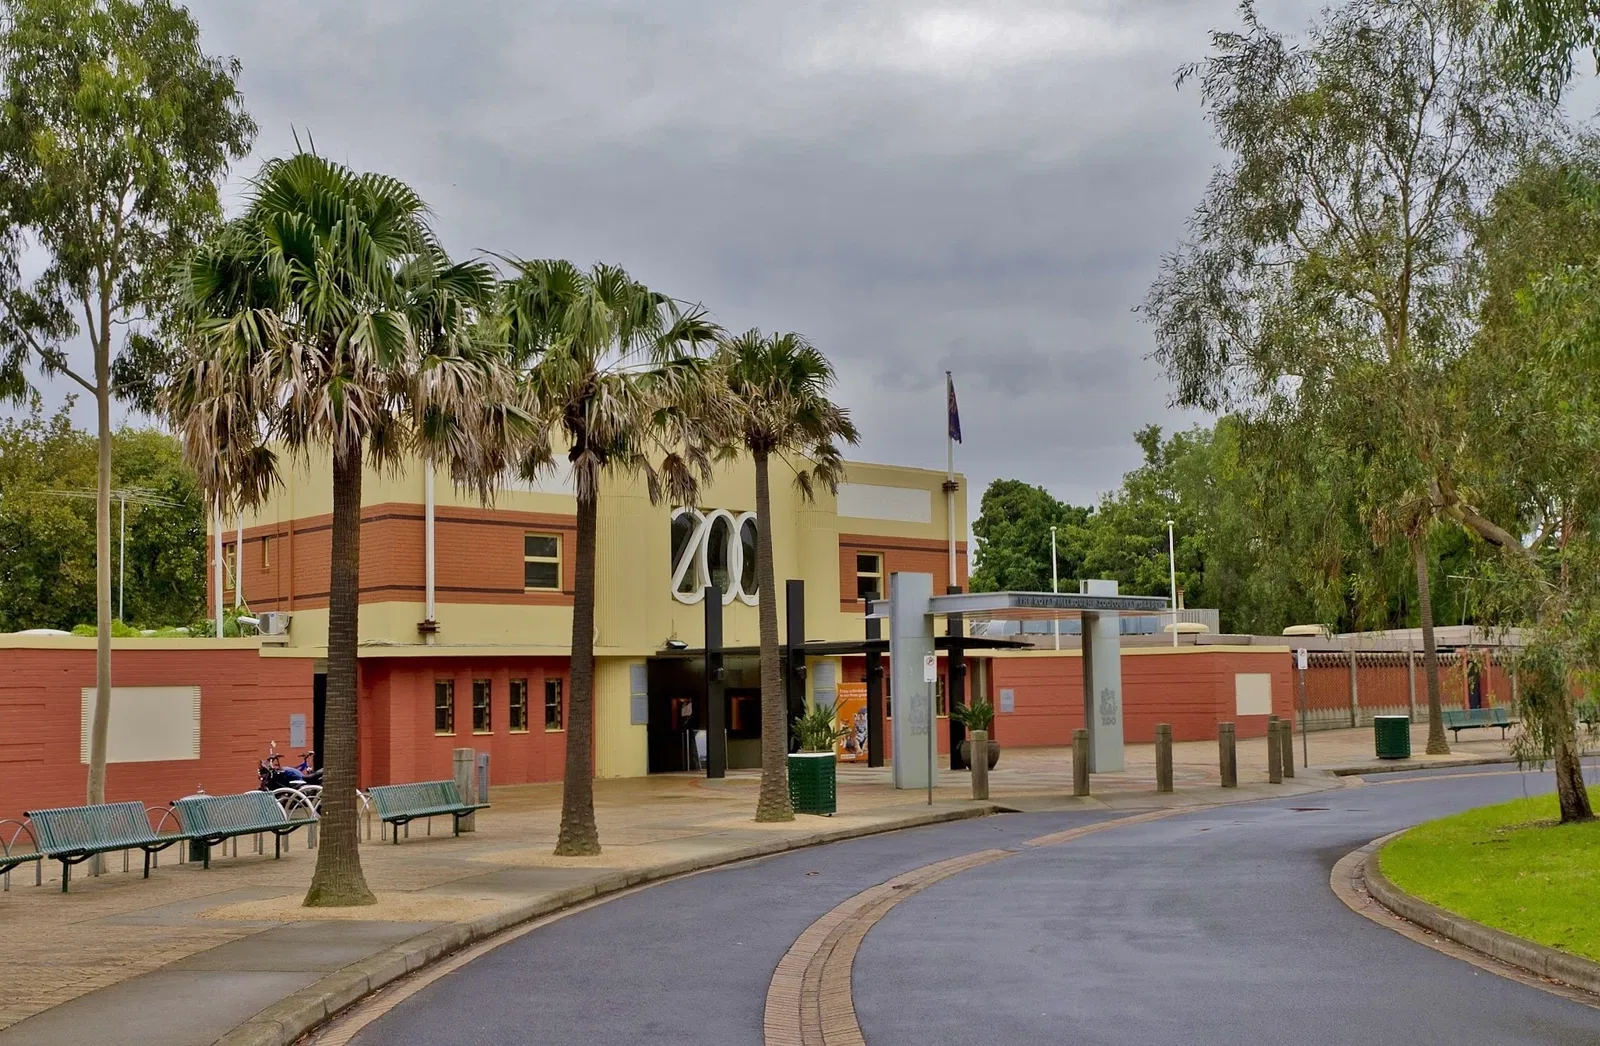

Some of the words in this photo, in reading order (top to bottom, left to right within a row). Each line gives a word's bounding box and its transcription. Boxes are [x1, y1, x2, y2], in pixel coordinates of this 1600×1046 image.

[1034, 597, 1057, 606] ROYAL
[1058, 598, 1097, 608] MELBOURNE
[1098, 599, 1136, 609] ZOOLOGICAL
[1101, 716, 1116, 726] ZOO
[910, 725, 928, 736] ZOO
